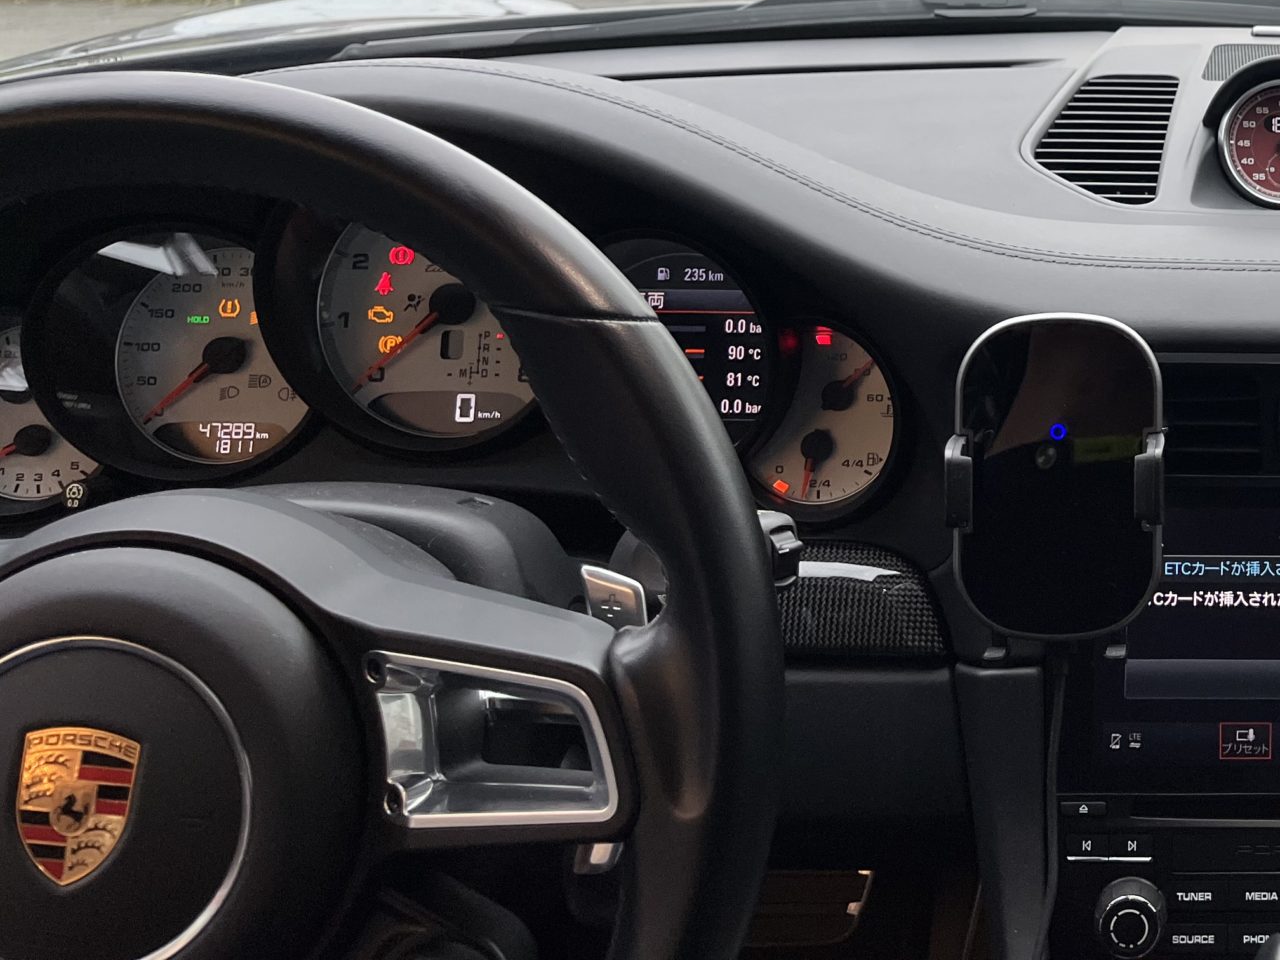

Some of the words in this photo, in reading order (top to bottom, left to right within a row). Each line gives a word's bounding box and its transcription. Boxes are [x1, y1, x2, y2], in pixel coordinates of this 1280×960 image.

[1242, 120, 1256, 128] 50
[1252, 173, 1266, 181] 35
[352, 253, 370, 270] 2
[684, 268, 706, 281] 235
[708, 270, 724, 281] km
[172, 284, 202, 293] 200
[148, 308, 175, 319] 150
[186, 315, 210, 324] HOLD
[338, 312, 350, 328] 1
[725, 319, 746, 334] 0.0
[484, 331, 491, 340] P
[134, 342, 161, 352] 100
[482, 344, 490, 352] R
[728, 346, 745, 360] 90
[748, 348, 762, 360] °C
[482, 357, 489, 366] N
[458, 369, 468, 378] M
[136, 376, 157, 386] 50
[726, 372, 742, 387] 81
[747, 375, 760, 387] °C
[866, 394, 884, 402] 60
[455, 393, 476, 422] 0
[478, 411, 501, 419] km/h
[721, 399, 742, 414] 0.0
[199, 423, 255, 439] 47289
[256, 431, 269, 439] km
[215, 440, 254, 454] 1811
[70, 462, 80, 470] 5
[842, 458, 864, 468] 4/4
[52, 468, 61, 477] 4
[775, 465, 784, 474] 0
[16, 472, 25, 482] 2
[34, 473, 44, 482] 3
[809, 479, 832, 488] 2/4
[1128, 732, 1142, 741] LTE
[28, 733, 138, 759] PORSCHE
[1222, 743, 1269, 755] プリセット
[1176, 892, 1212, 902] TUNER
[1244, 892, 1278, 902] MEDIA
[1172, 934, 1215, 944] SOURCE
